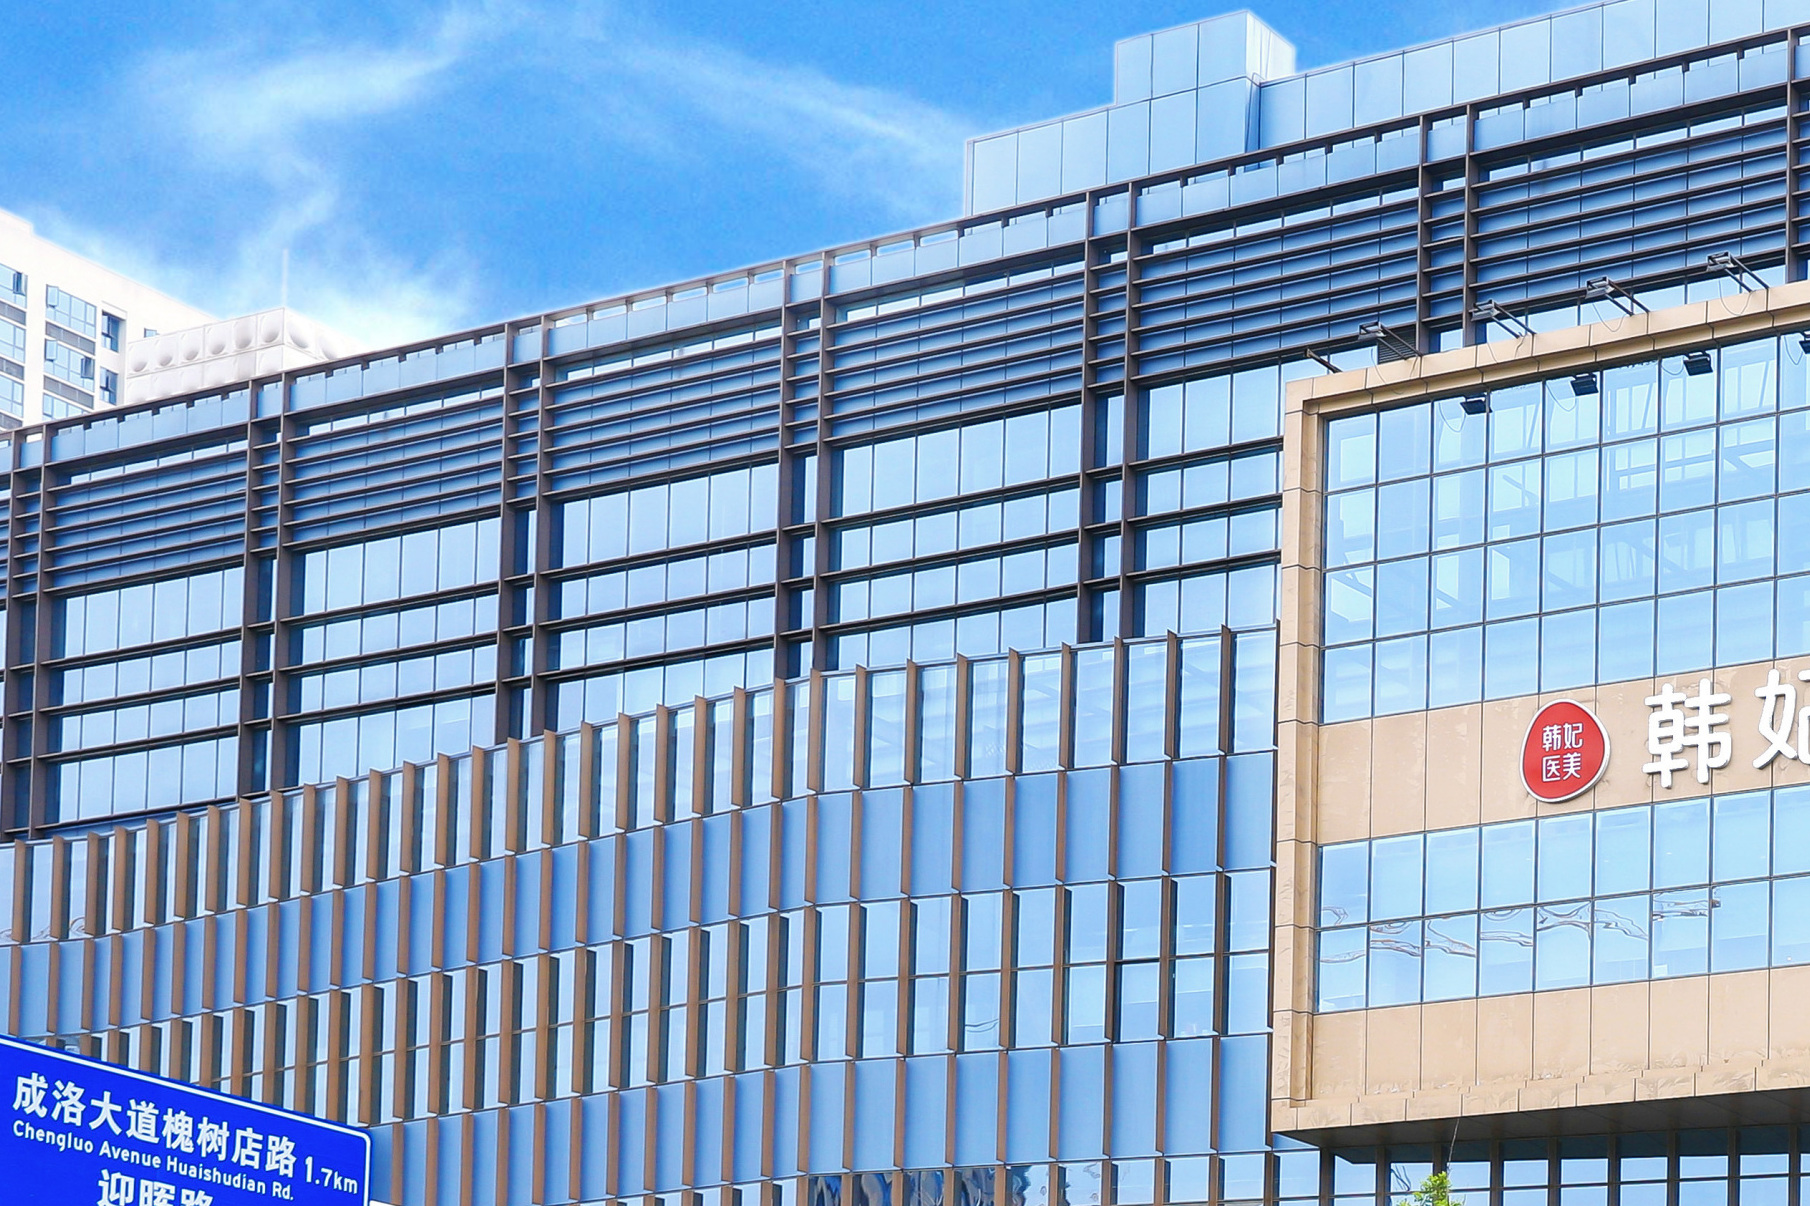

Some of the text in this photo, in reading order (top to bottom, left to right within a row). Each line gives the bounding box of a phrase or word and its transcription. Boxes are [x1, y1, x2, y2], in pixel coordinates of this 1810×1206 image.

[1542, 722, 1583, 752] 韩妃
[1542, 752, 1582, 782] 医美
[12, 1072, 359, 1195] 成洛大道槐树店路 1.7km
[13, 1119, 294, 1201] Chengluo Avenue Huaishudian Rd.
